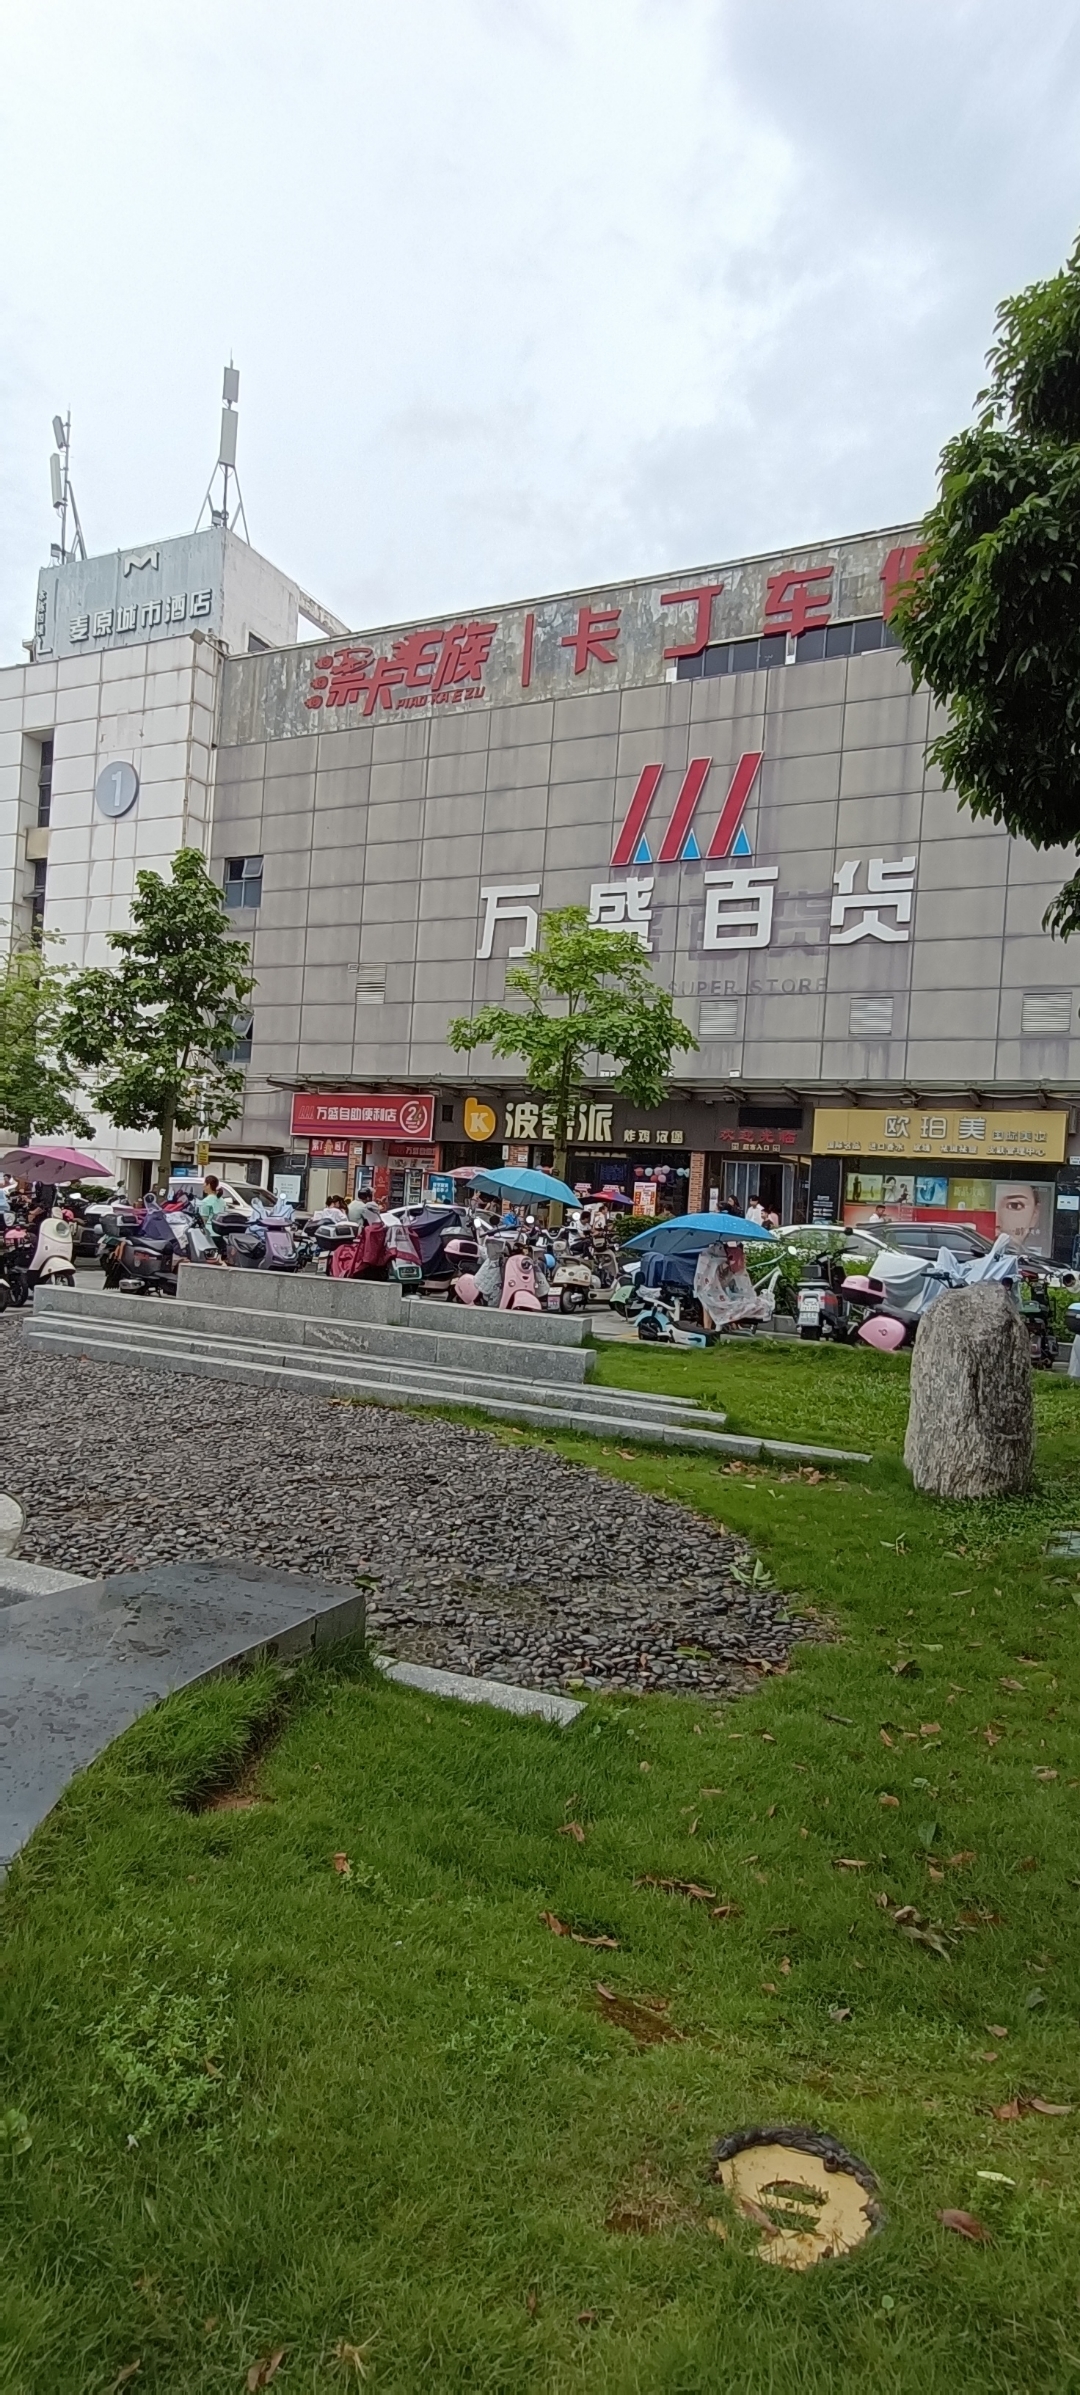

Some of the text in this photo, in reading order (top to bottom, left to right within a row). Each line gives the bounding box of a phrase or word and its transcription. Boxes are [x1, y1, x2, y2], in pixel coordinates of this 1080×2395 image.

[69, 588, 212, 644] 麦原城市酒店
[111, 770, 122, 807] 1
[476, 856, 917, 959] 万盛百货
[316, 1106, 397, 1122] 万盛自助便利店
[623, 1129, 684, 1144] 炸鸡 汉堡
[719, 1128, 797, 1145] 欢迎光临
[884, 1115, 987, 1140] 欧珀美
